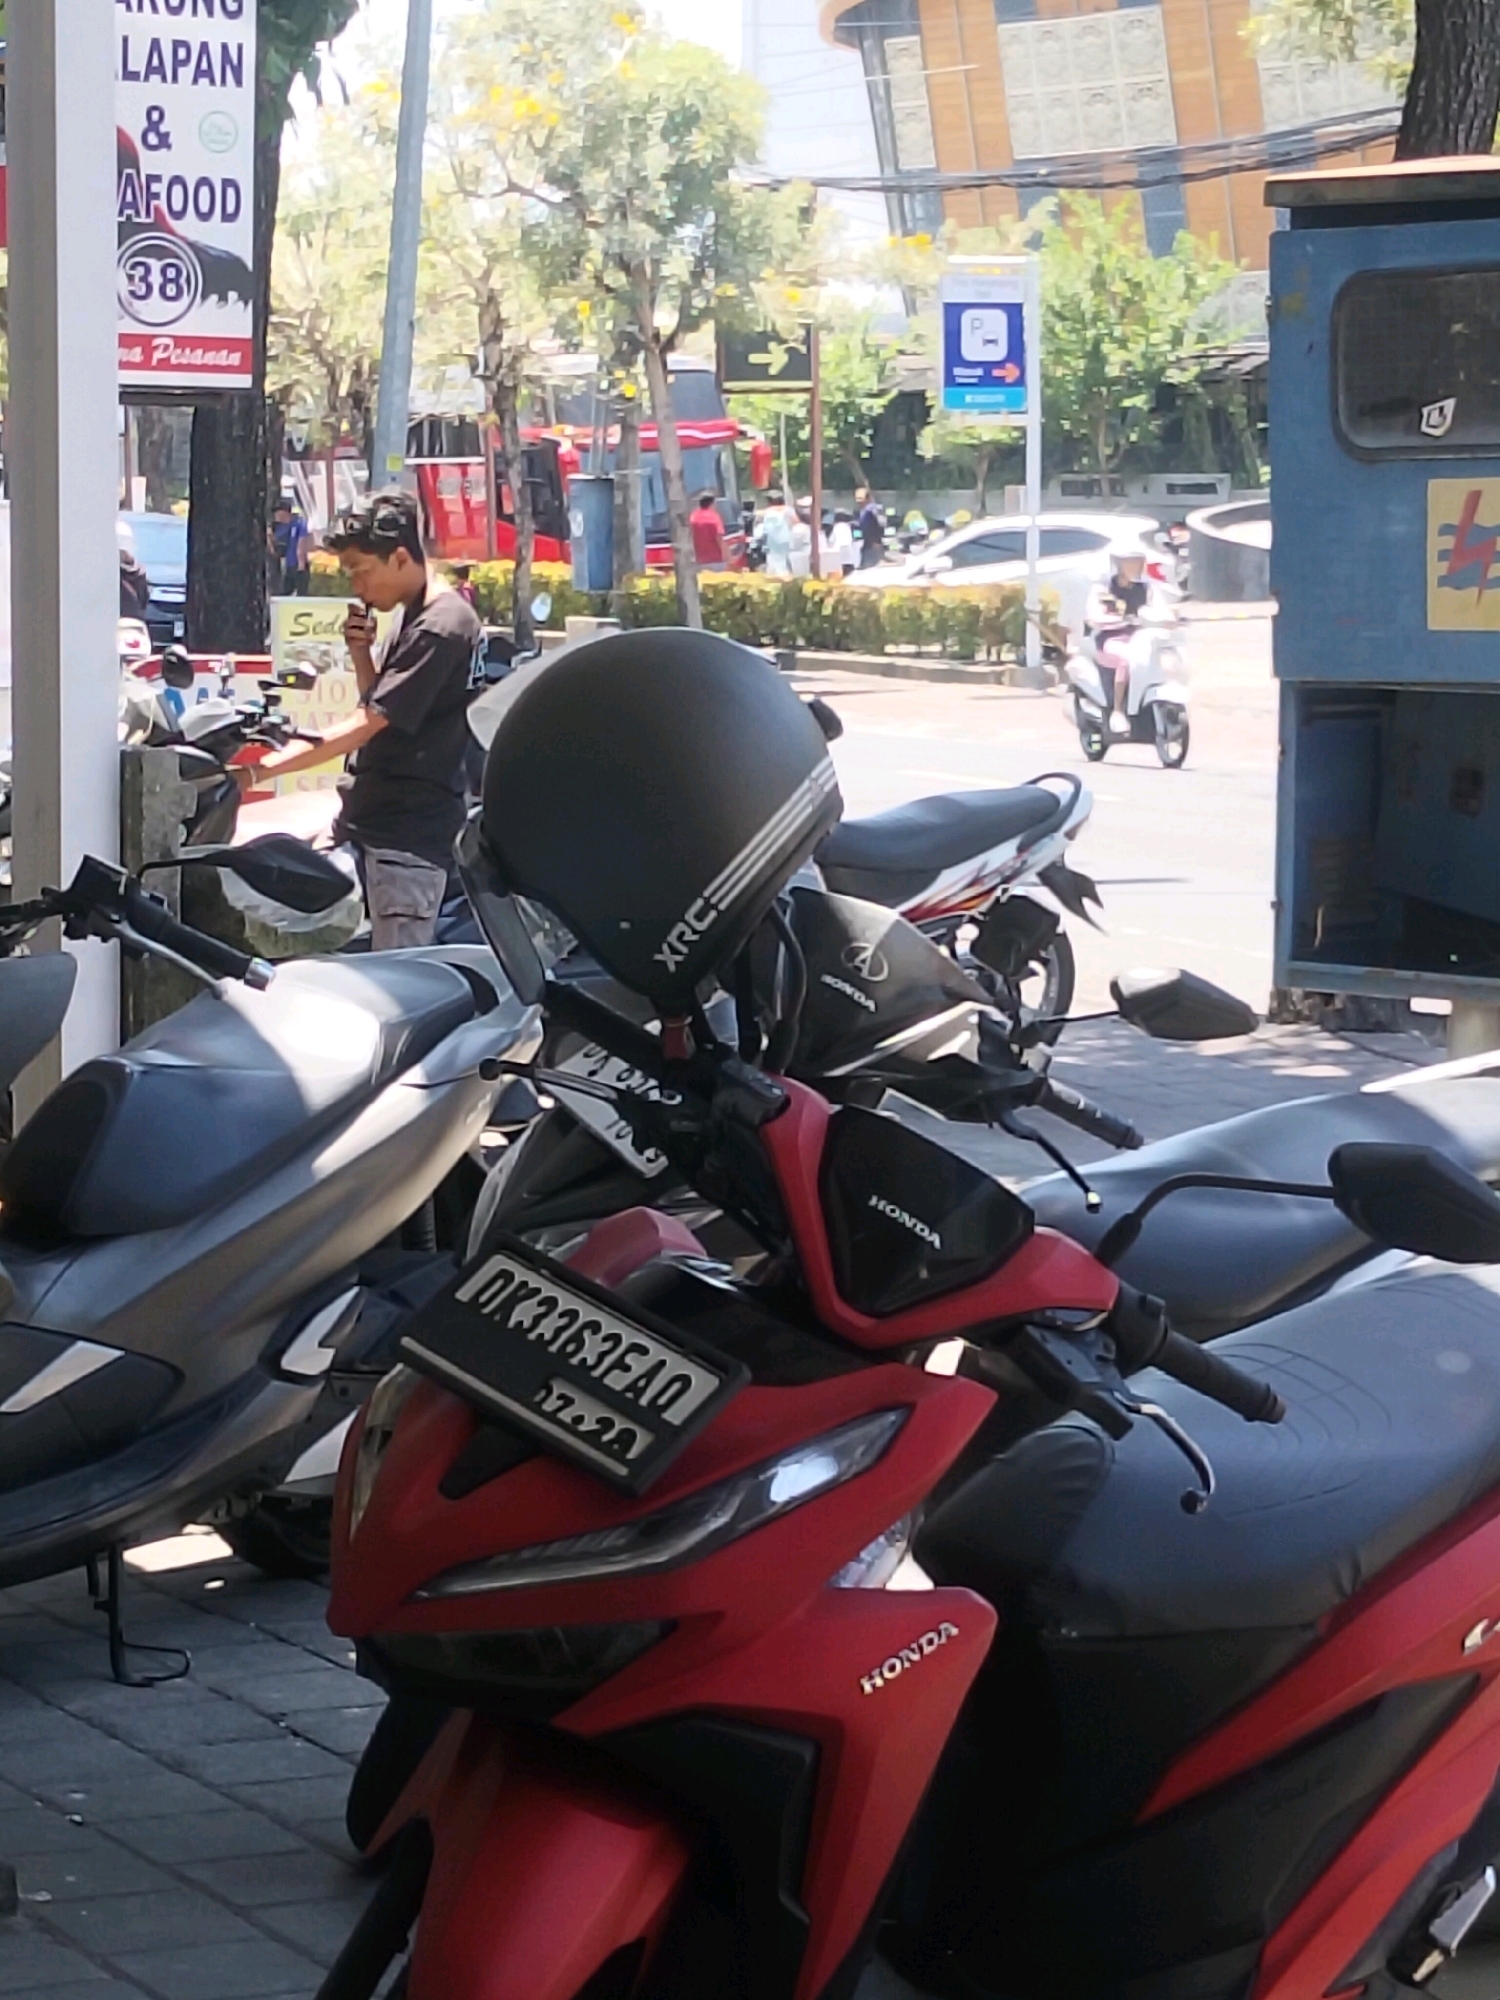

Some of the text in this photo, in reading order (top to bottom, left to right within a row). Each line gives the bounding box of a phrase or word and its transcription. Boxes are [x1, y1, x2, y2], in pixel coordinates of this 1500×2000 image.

[115, 35, 244, 88] LAPAN
[141, 104, 173, 152] &
[117, 171, 242, 224] AFOOD
[127, 259, 185, 303] 38
[151, 336, 242, 367] Pesanan
[653, 897, 718, 972] XRC
[821, 974, 877, 1013] HONDA
[868, 1194, 942, 1250] HONDA
[860, 1621, 959, 1695] HONDA
